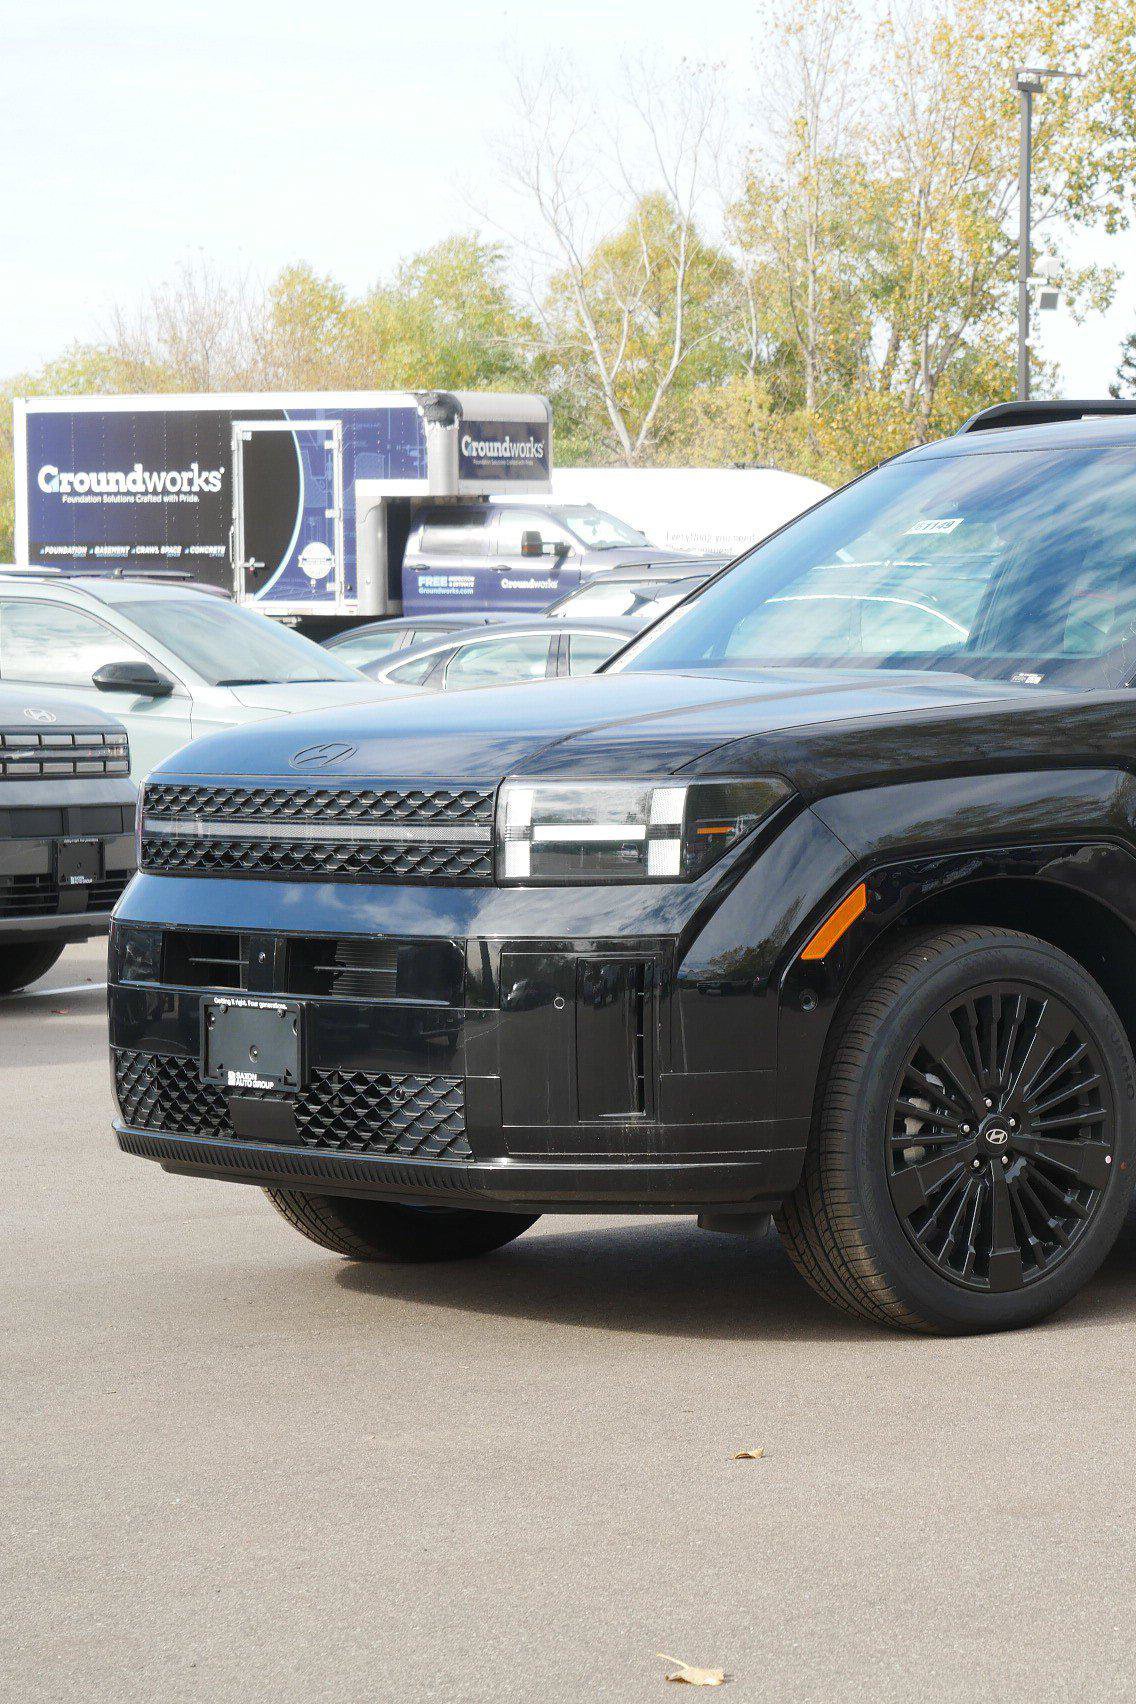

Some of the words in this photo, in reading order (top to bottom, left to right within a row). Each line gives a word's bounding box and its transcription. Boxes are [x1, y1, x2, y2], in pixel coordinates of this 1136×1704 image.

[62, 494, 101, 503] Foundation
[103, 494, 134, 503] Solutions
[136, 494, 162, 503] Crafted
[163, 494, 178, 503] with
[179, 494, 200, 503] Pride.
[44, 546, 87, 555] FOUNDATION
[94, 546, 130, 554] BASEMENT
[135, 546, 159, 554] CRAWL
[160, 546, 182, 554] SPACE
[189, 546, 226, 554] CONCRETE
[418, 576, 448, 587] FREE
[418, 587, 473, 595] Groundworks.com
[236, 1072, 257, 1080] SAXON
[236, 1079, 252, 1087] AUTO
[253, 1080, 275, 1089] GROUP
